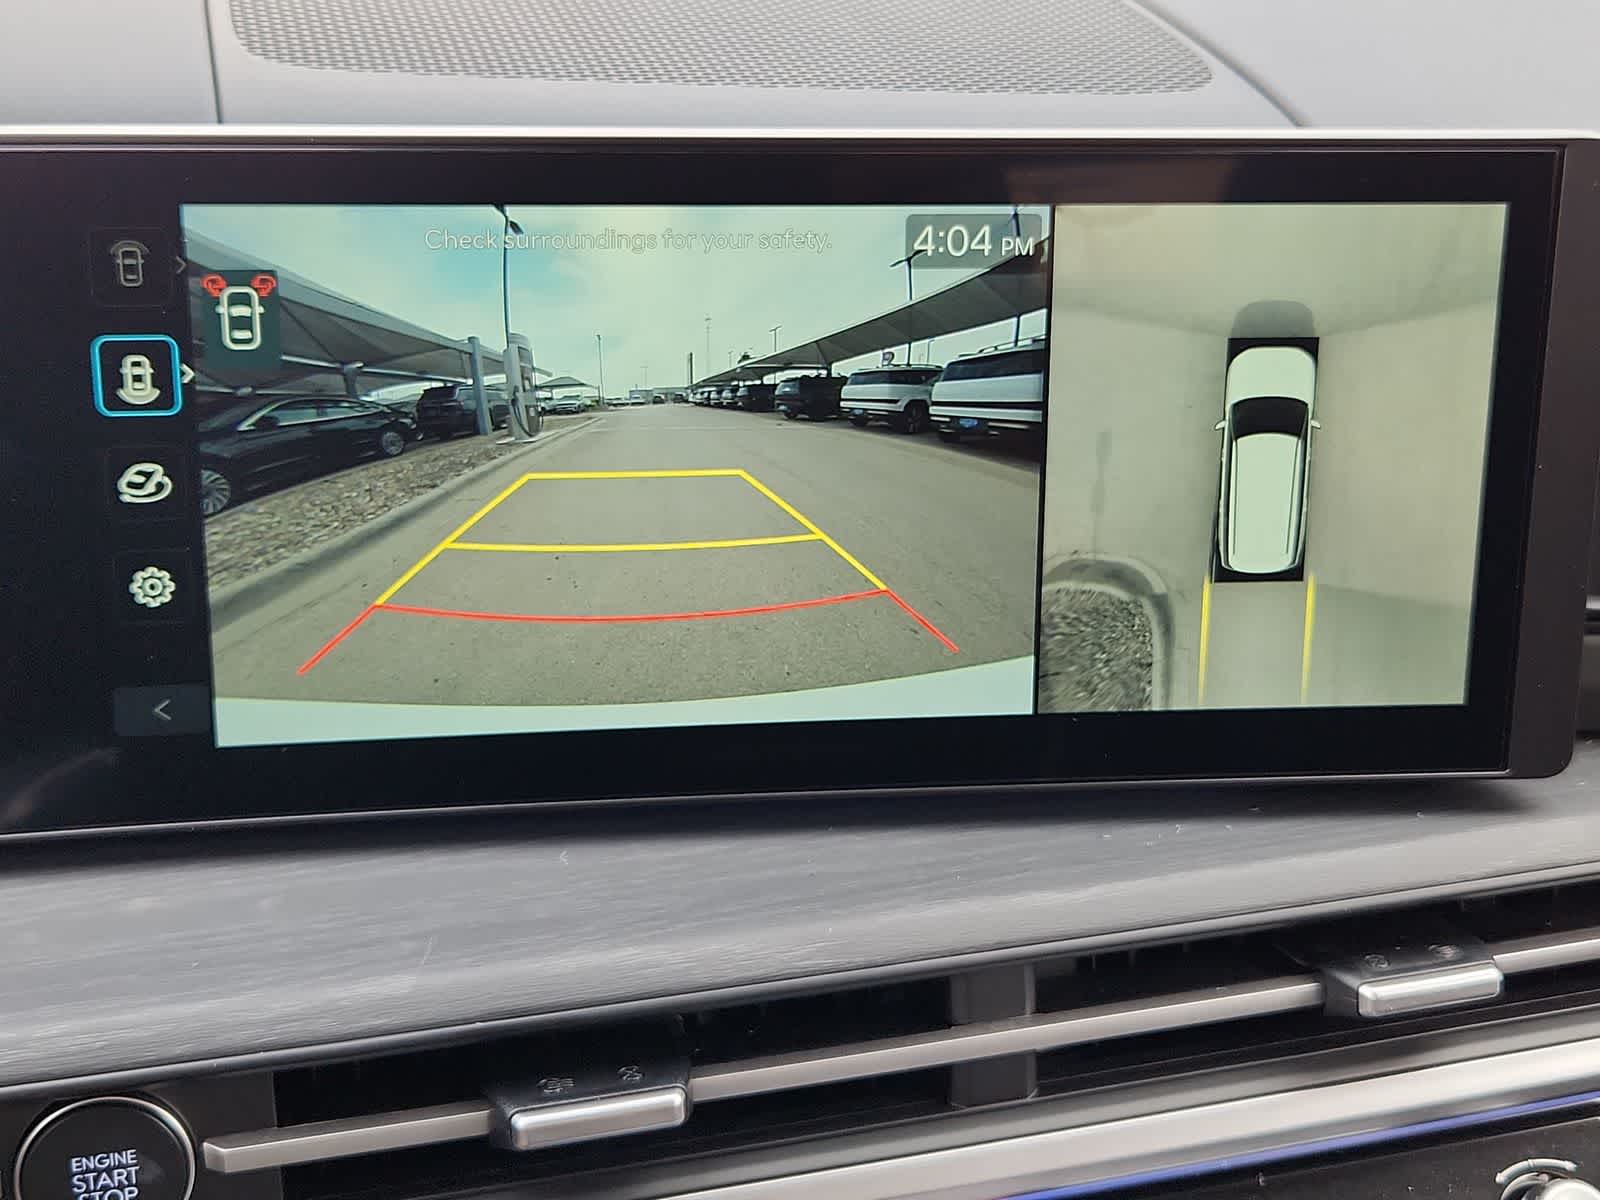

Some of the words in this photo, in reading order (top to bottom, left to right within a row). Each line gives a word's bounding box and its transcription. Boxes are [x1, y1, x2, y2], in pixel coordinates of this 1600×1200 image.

[425, 229, 498, 250] Check
[504, 228, 658, 254] surroundings
[662, 227, 697, 250] for
[701, 233, 753, 254] your
[759, 227, 832, 254] safety.
[913, 224, 992, 257] 4:04
[1001, 237, 1035, 257] PM
[71, 1149, 138, 1172] ENGINE
[72, 1166, 140, 1193] START
